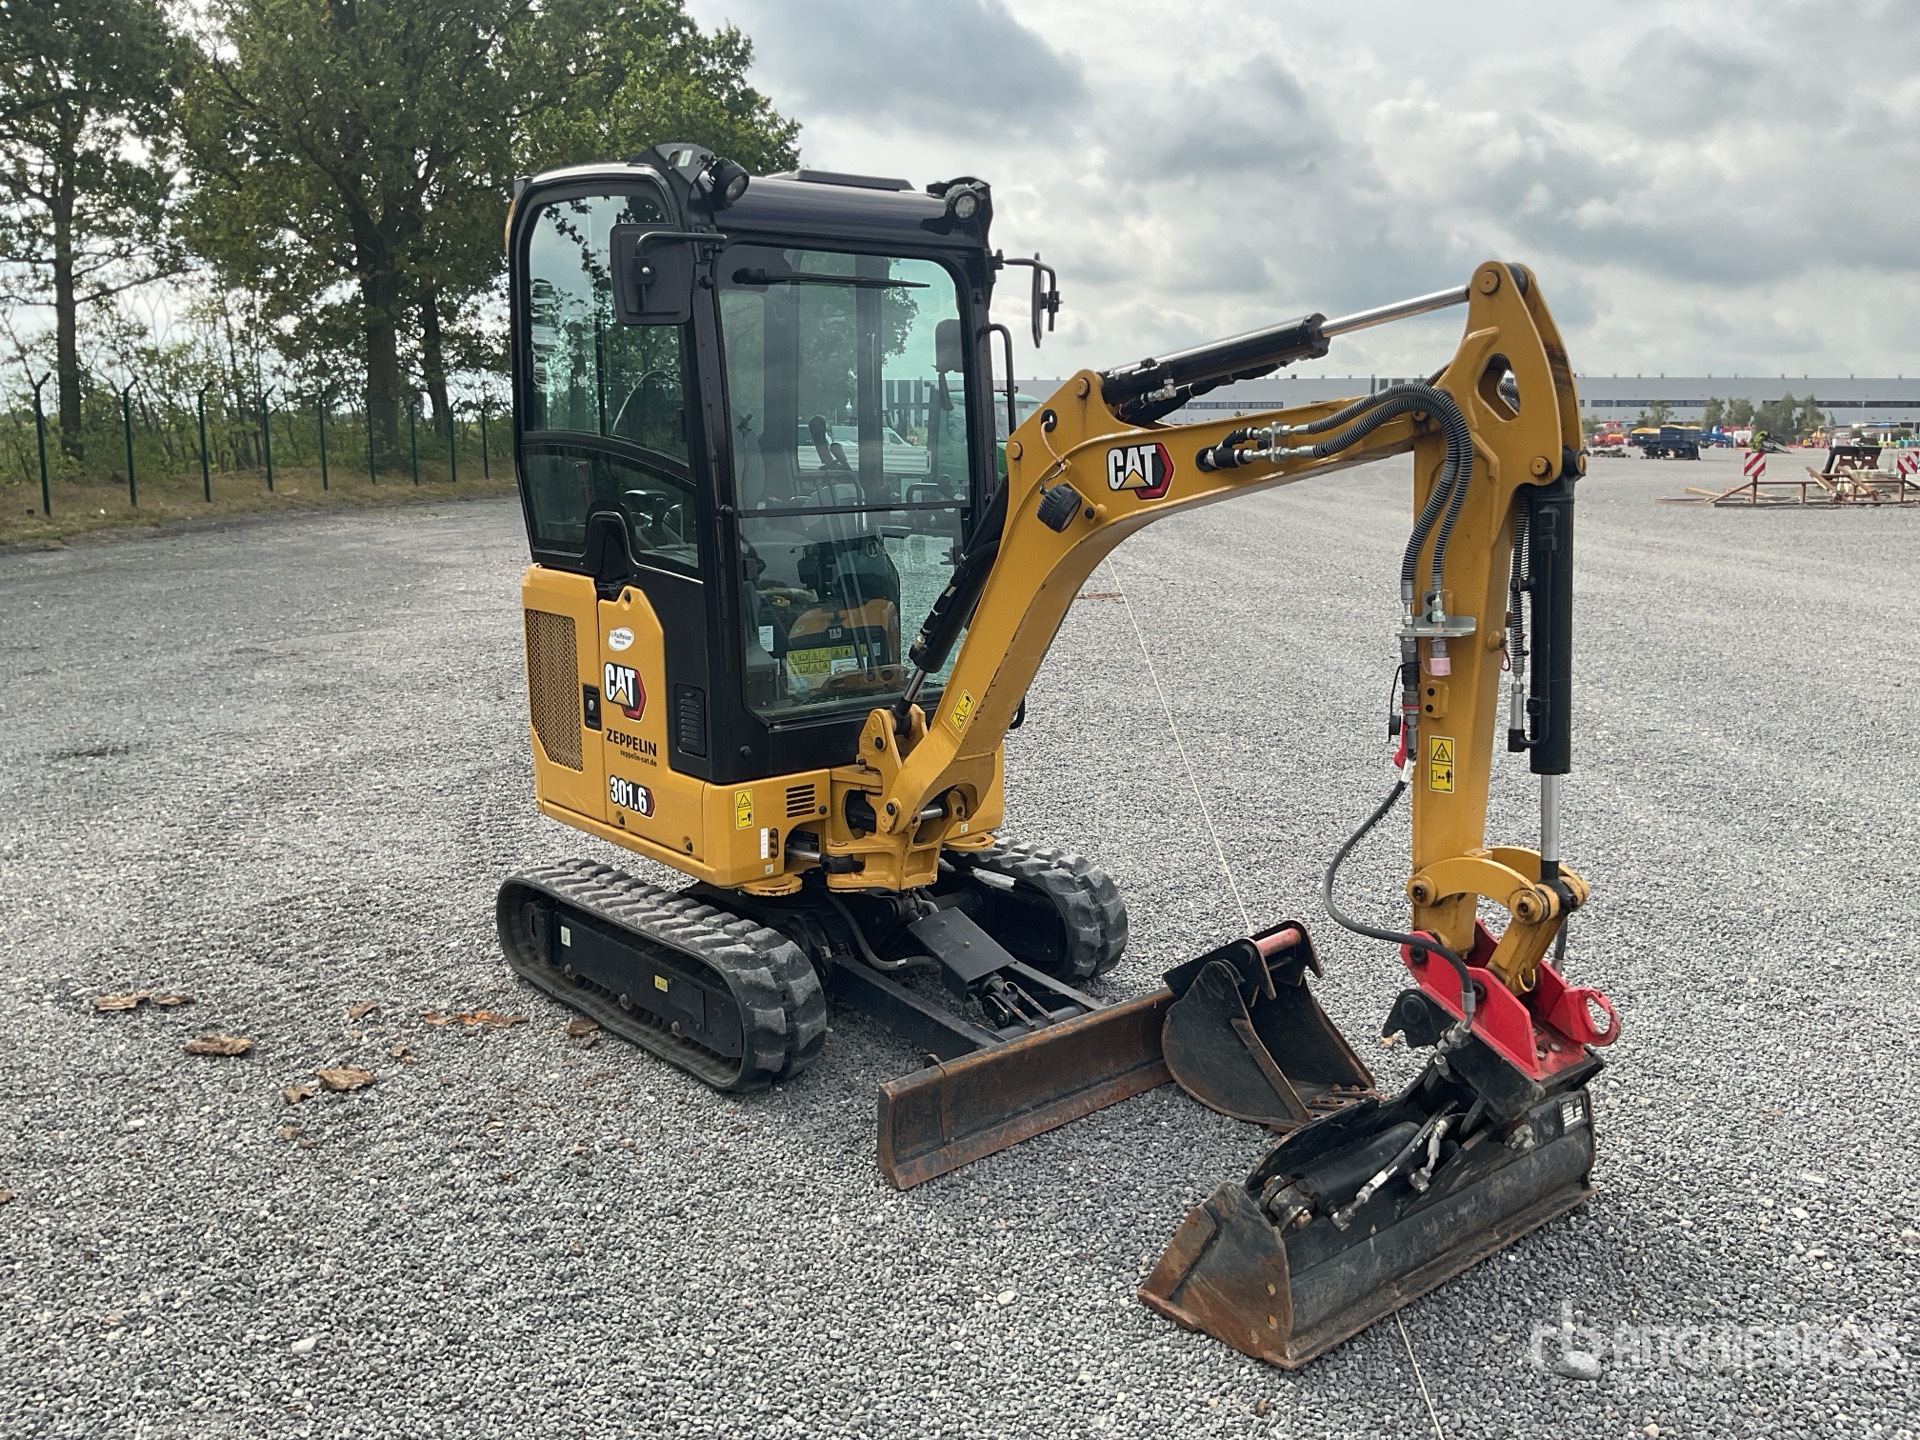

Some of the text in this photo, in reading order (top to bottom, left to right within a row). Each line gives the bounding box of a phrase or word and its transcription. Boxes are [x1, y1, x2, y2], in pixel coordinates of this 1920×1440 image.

[1108, 444, 1157, 490] CAT
[605, 663, 636, 708] CAT
[606, 727, 657, 757] ZEPPELIN
[620, 750, 657, 767] zeppelin-cat.de
[609, 775, 648, 814] 301.6
